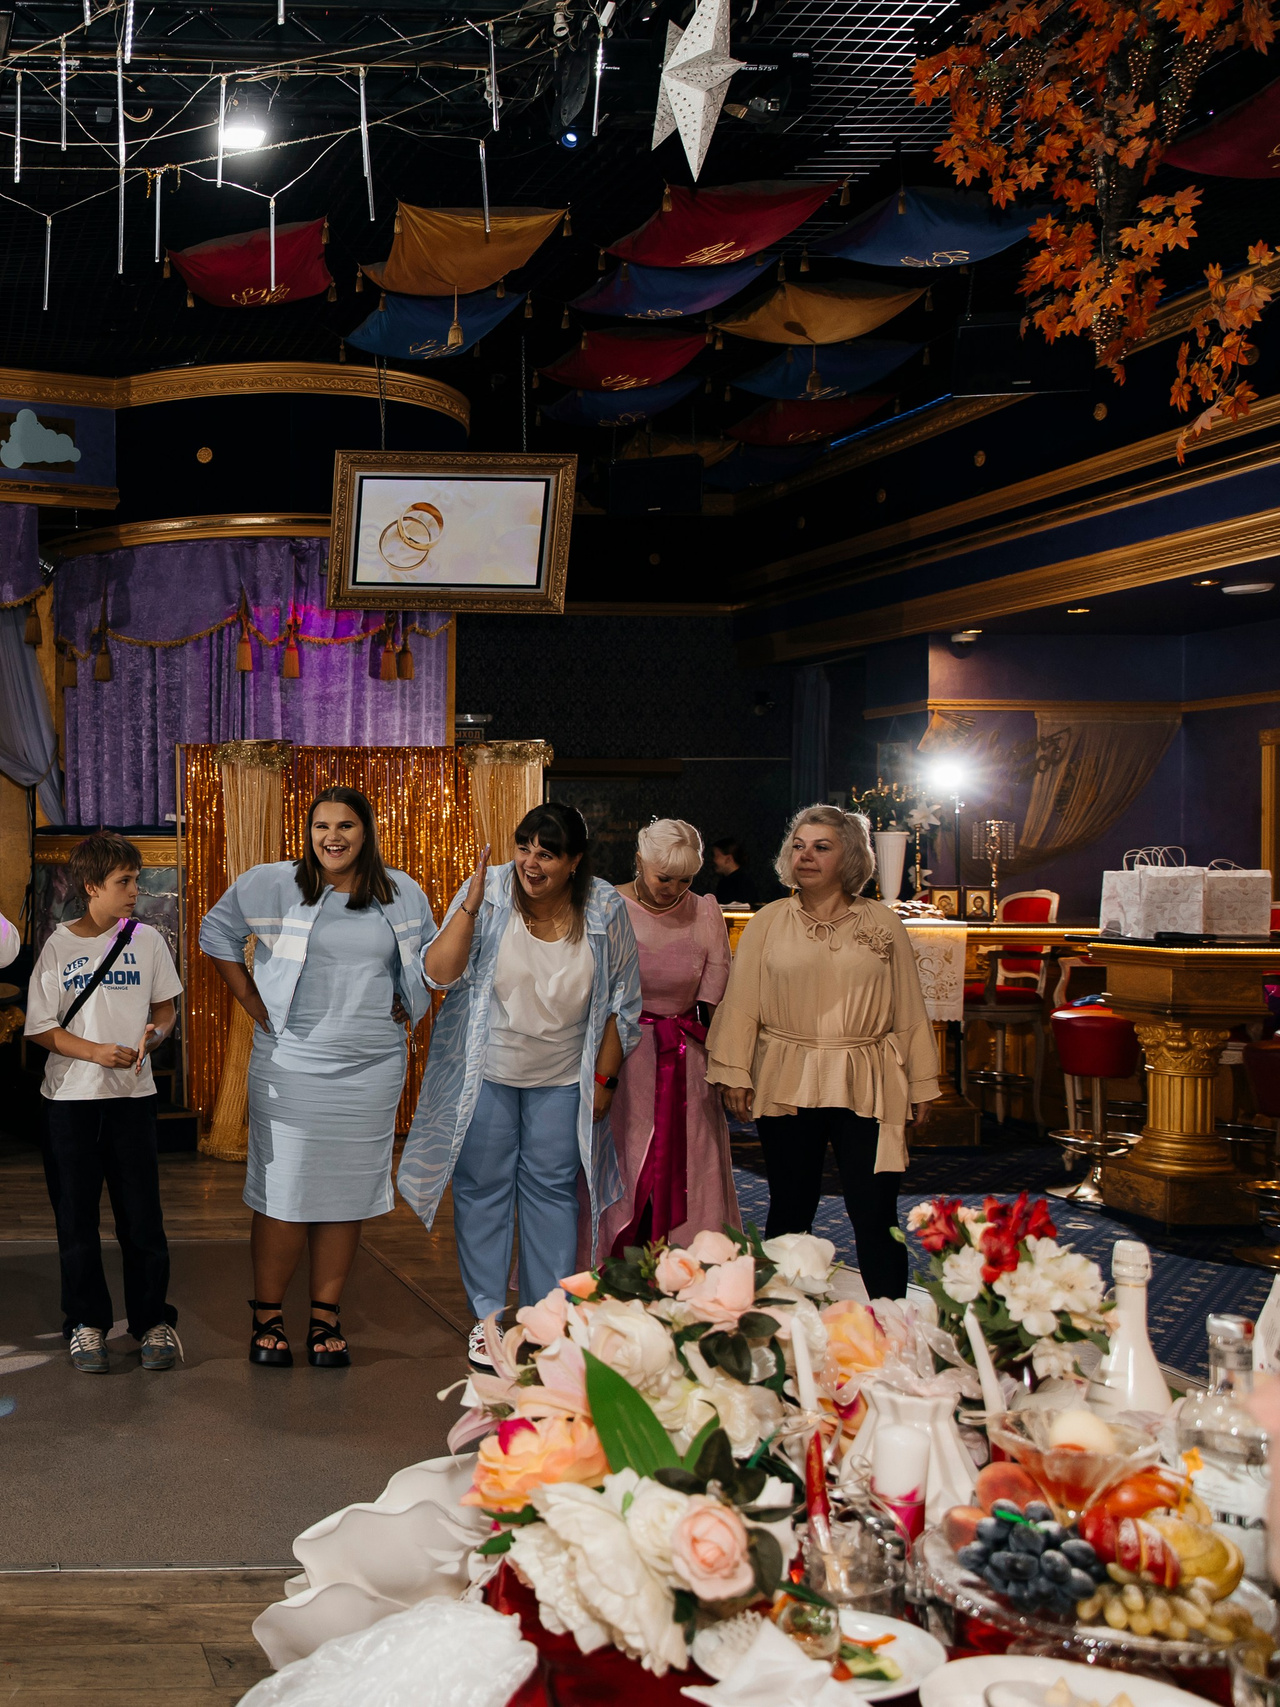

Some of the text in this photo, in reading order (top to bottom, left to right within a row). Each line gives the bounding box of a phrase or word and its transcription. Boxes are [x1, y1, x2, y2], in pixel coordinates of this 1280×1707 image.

[455, 730, 481, 740] ЫХОД
[123, 952, 137, 964] 11
[67, 960, 84, 971] YES
[63, 970, 141, 991] FREDOM
